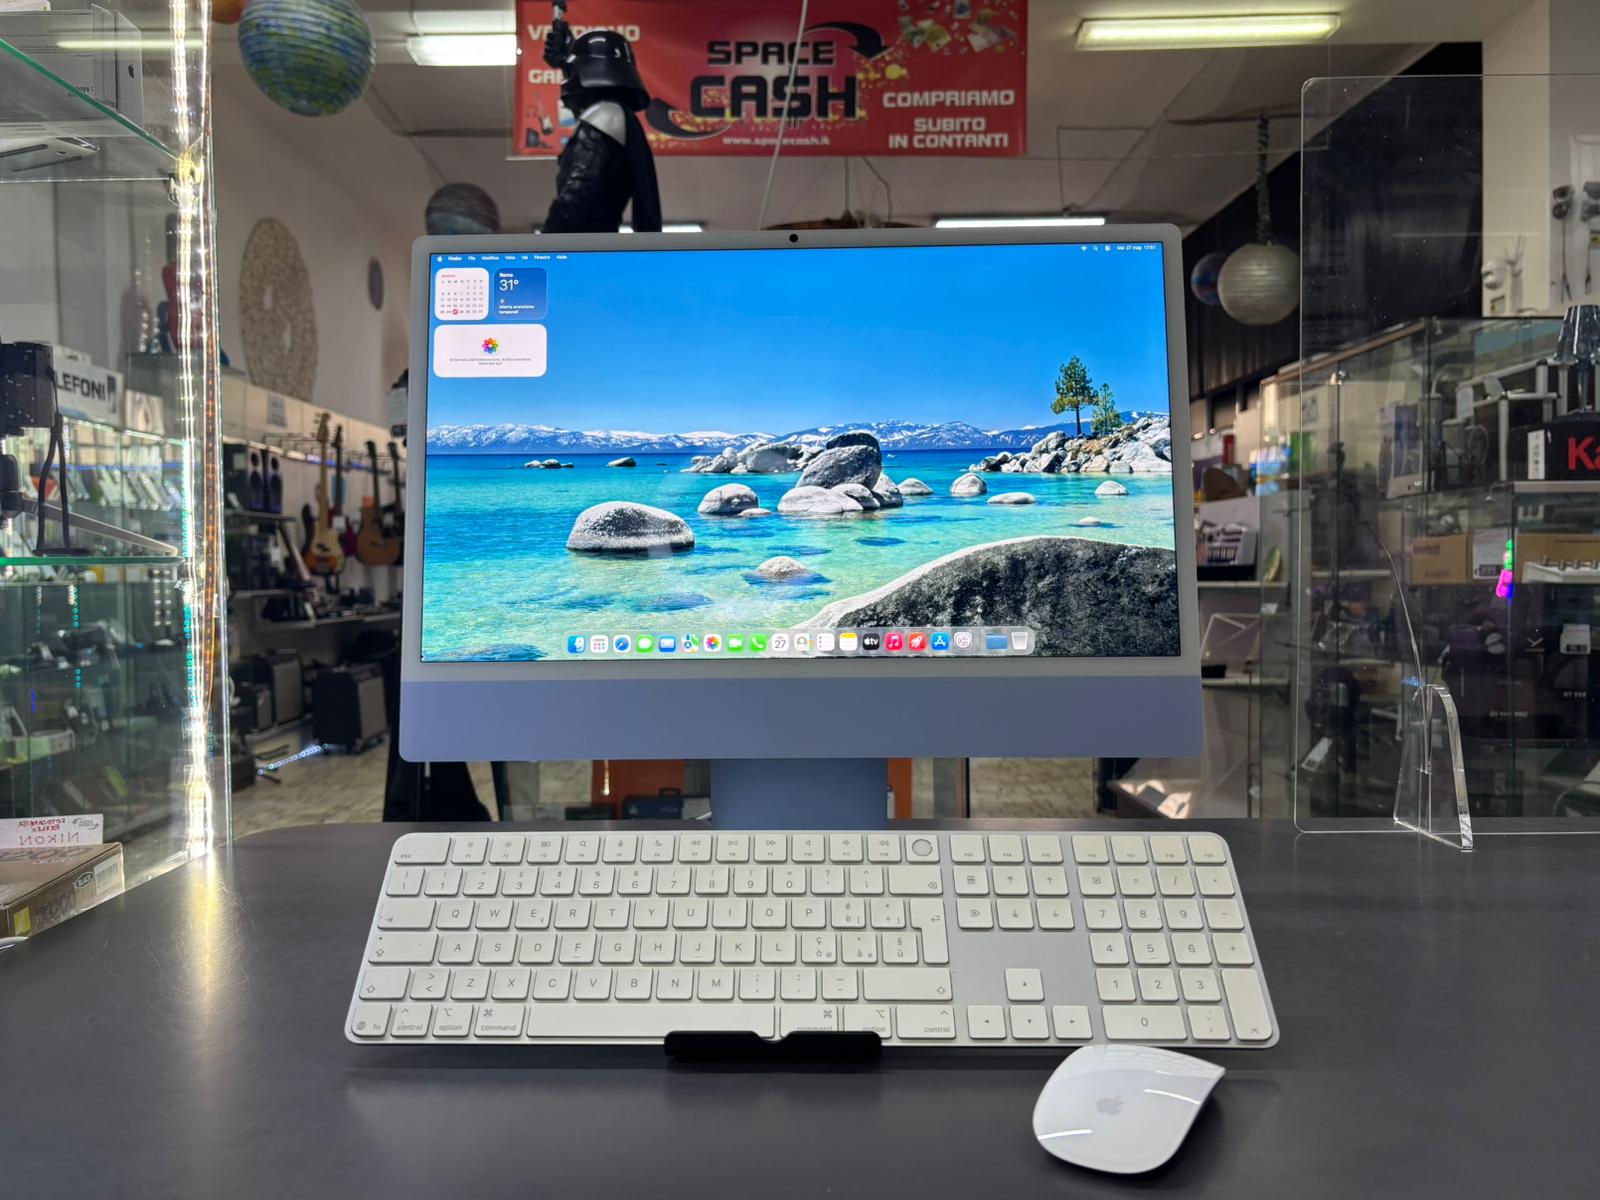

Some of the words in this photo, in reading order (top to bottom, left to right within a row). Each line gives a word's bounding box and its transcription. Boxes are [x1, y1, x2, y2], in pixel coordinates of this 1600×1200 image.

[707, 41, 836, 66] SPACE
[689, 75, 857, 119] CASH
[882, 90, 1016, 108] COMPRIAMO
[913, 117, 987, 132] SUBITO
[722, 136, 831, 148] www.spacecash.it
[888, 134, 909, 149] IN
[912, 133, 1009, 148] CONTANTI
[1568, 436, 1600, 470] K
[774, 640, 786, 649] 27
[477, 881, 485, 890] 2
[515, 881, 523, 890] 3
[553, 881, 561, 889] 4
[592, 880, 601, 890] 5
[631, 879, 639, 890] 6
[670, 879, 678, 890] 7
[708, 879, 716, 890] 8
[746, 879, 755, 890] 9
[785, 879, 793, 890] 0
[451, 908, 460, 919] Q
[489, 909, 501, 918] W
[529, 908, 538, 919] E
[568, 908, 577, 918] R
[608, 908, 617, 918] T
[647, 907, 656, 917] Y
[686, 908, 695, 917] U
[765, 907, 774, 918] O
[805, 907, 813, 917] P
[1098, 909, 1107, 919] 7
[1138, 909, 1148, 919] 8
[1179, 909, 1188, 919] 9
[453, 943, 462, 952] A
[493, 942, 502, 953] S
[533, 942, 543, 952] D
[574, 942, 582, 952] F
[613, 942, 622, 952] G
[653, 942, 663, 952] H
[694, 942, 702, 952] J
[734, 942, 743, 952] K
[775, 942, 783, 952] L
[1106, 943, 1114, 953] 4
[1146, 943, 1155, 954] 5
[1187, 943, 1196, 954] 6
[466, 977, 476, 988] Z
[506, 978, 516, 988] X
[548, 977, 558, 988] C
[589, 978, 598, 988] V
[630, 978, 639, 988] B
[671, 978, 680, 988] N
[711, 978, 721, 988] M
[1153, 979, 1163, 990] 2
[1195, 979, 1205, 990] 3
[396, 1022, 424, 1032] control
[1140, 1016, 1149, 1028] 0
[438, 1023, 463, 1032] option
[480, 1023, 517, 1032] command
[923, 1025, 951, 1033] control
